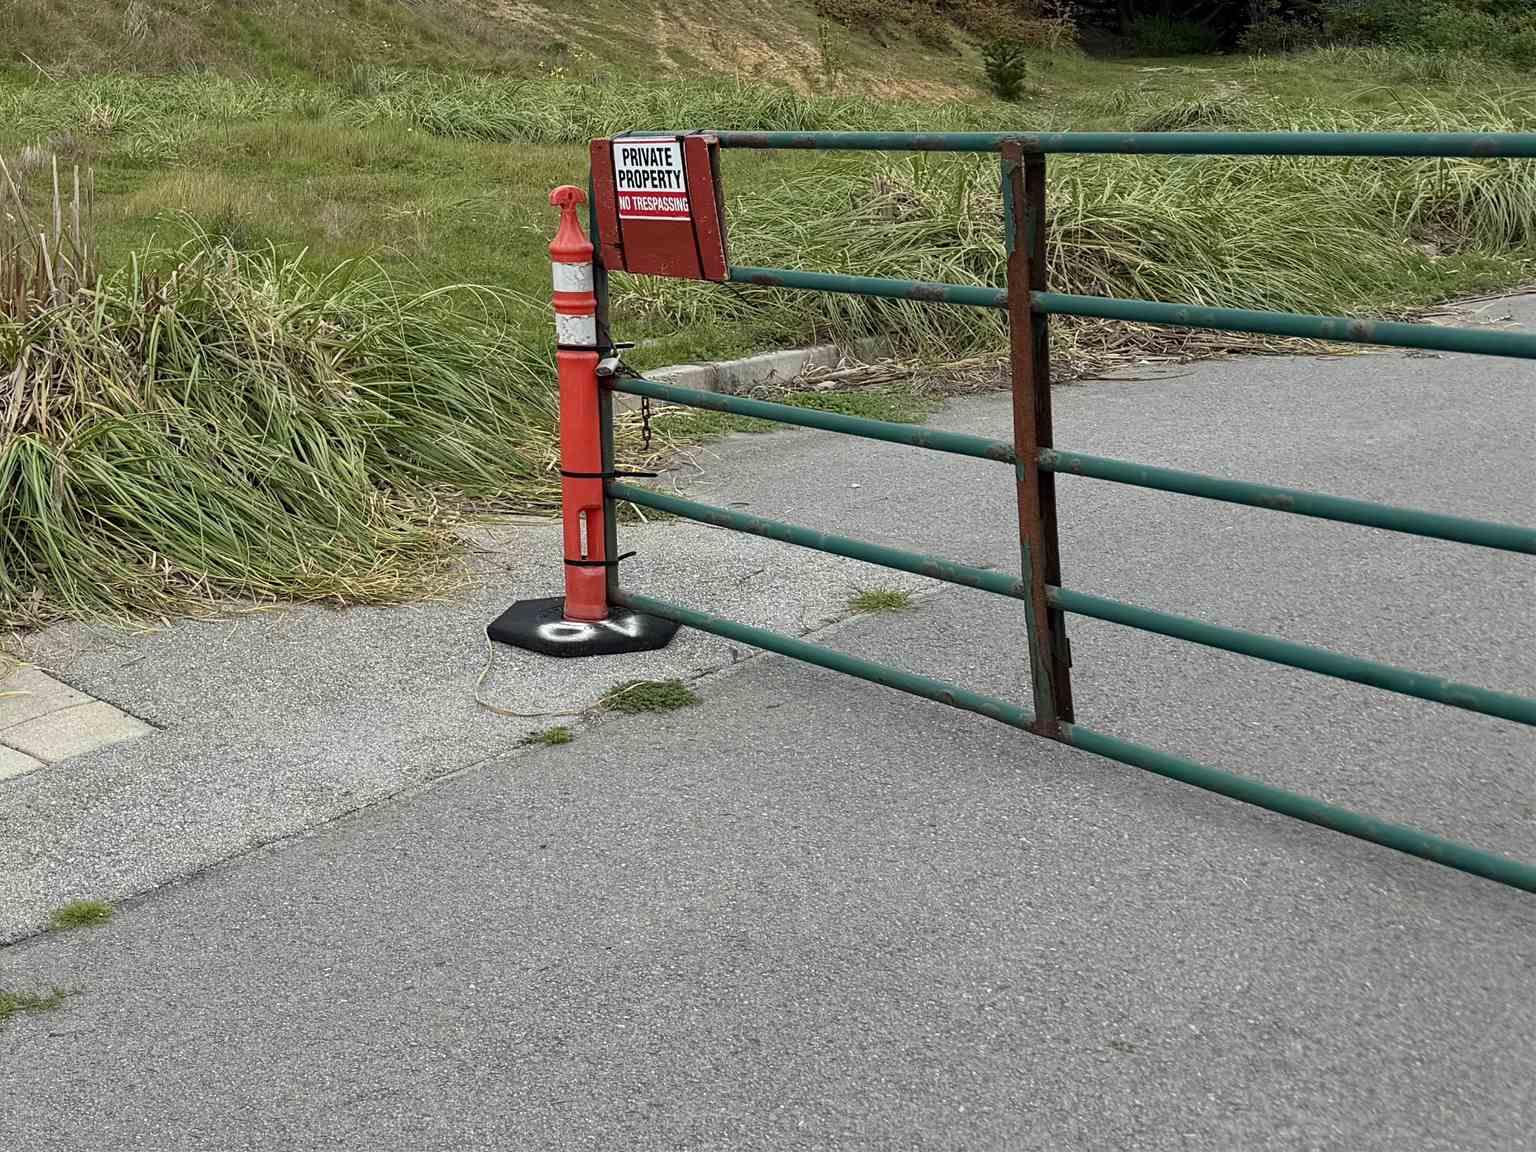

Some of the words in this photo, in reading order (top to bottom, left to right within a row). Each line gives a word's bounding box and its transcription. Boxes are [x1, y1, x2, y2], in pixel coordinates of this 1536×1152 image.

[622, 147, 673, 167] PRIVATE
[618, 169, 681, 189] PROPERTY
[619, 196, 631, 210] NO
[632, 196, 689, 211] TRESPASSING
